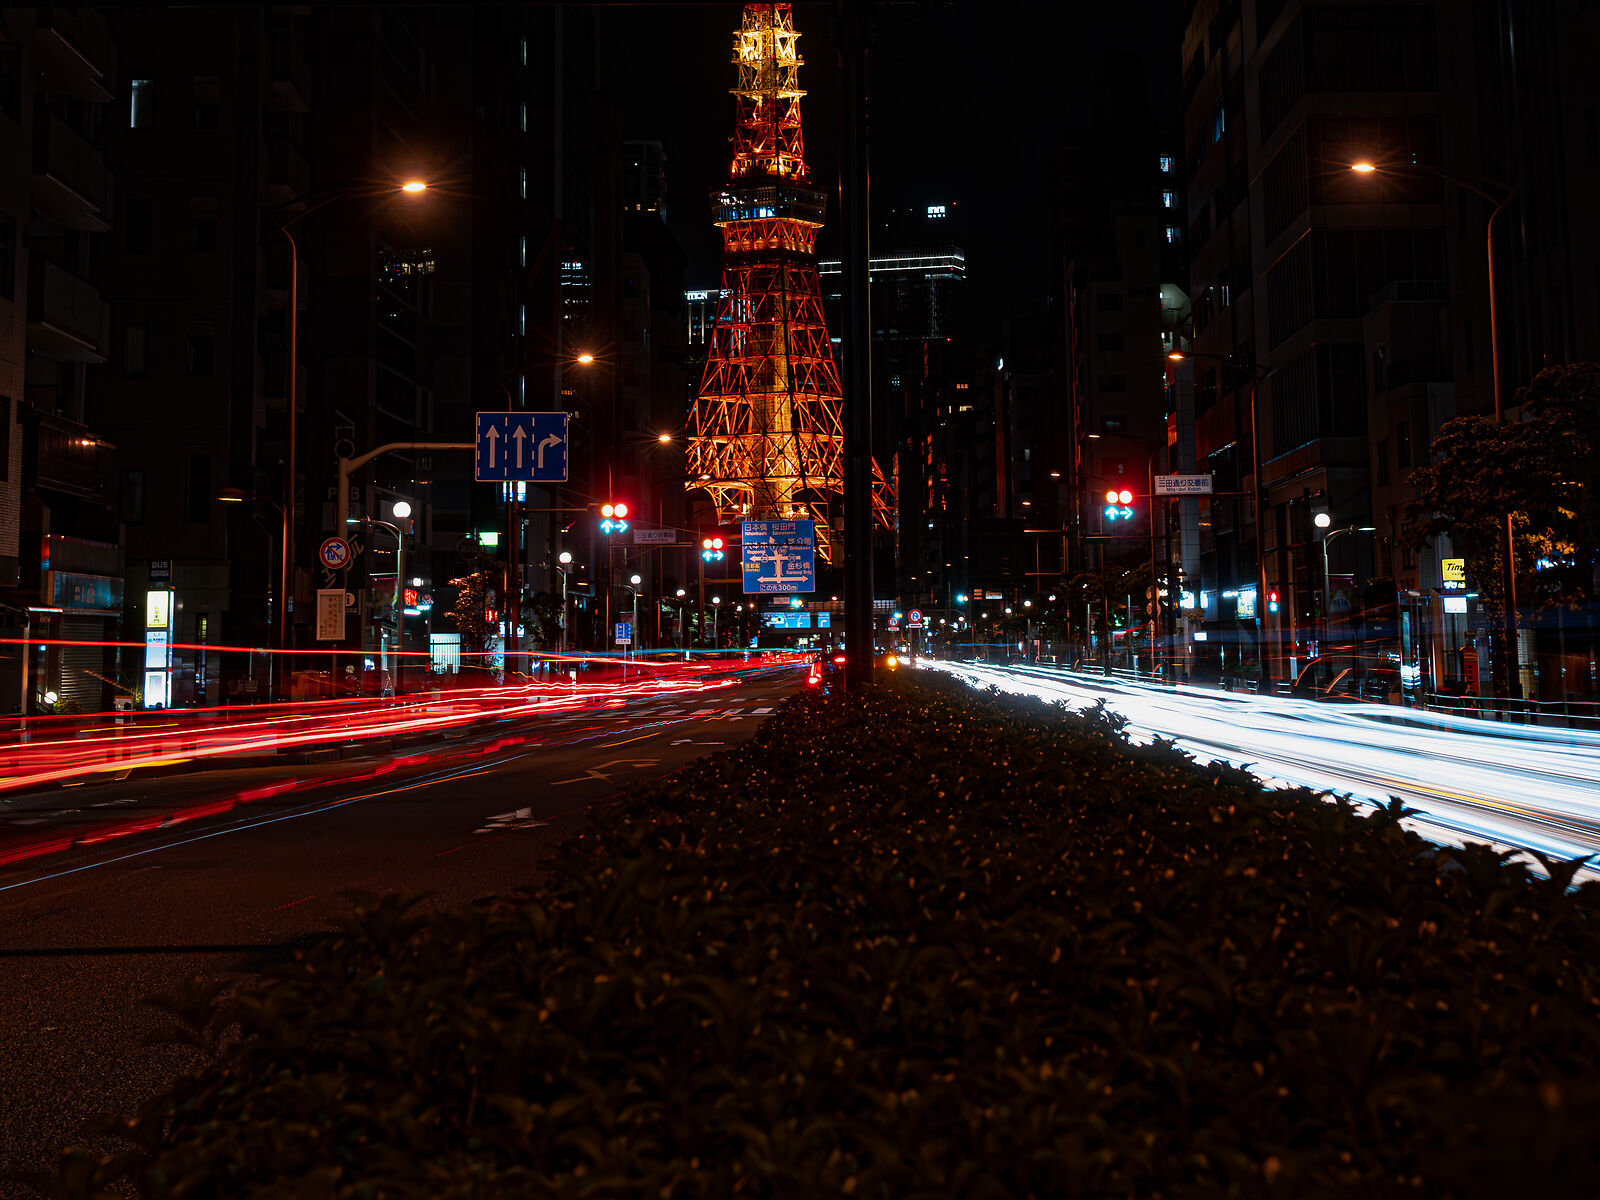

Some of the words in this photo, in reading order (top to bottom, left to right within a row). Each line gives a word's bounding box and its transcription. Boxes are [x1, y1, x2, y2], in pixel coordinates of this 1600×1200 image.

[327, 486, 360, 500] PB
[744, 523, 768, 532] 日本橋
[772, 522, 796, 531] 桜田門
[744, 541, 769, 550] 六本木
[151, 561, 169, 569] BUS
[787, 562, 811, 570] 金杉橋
